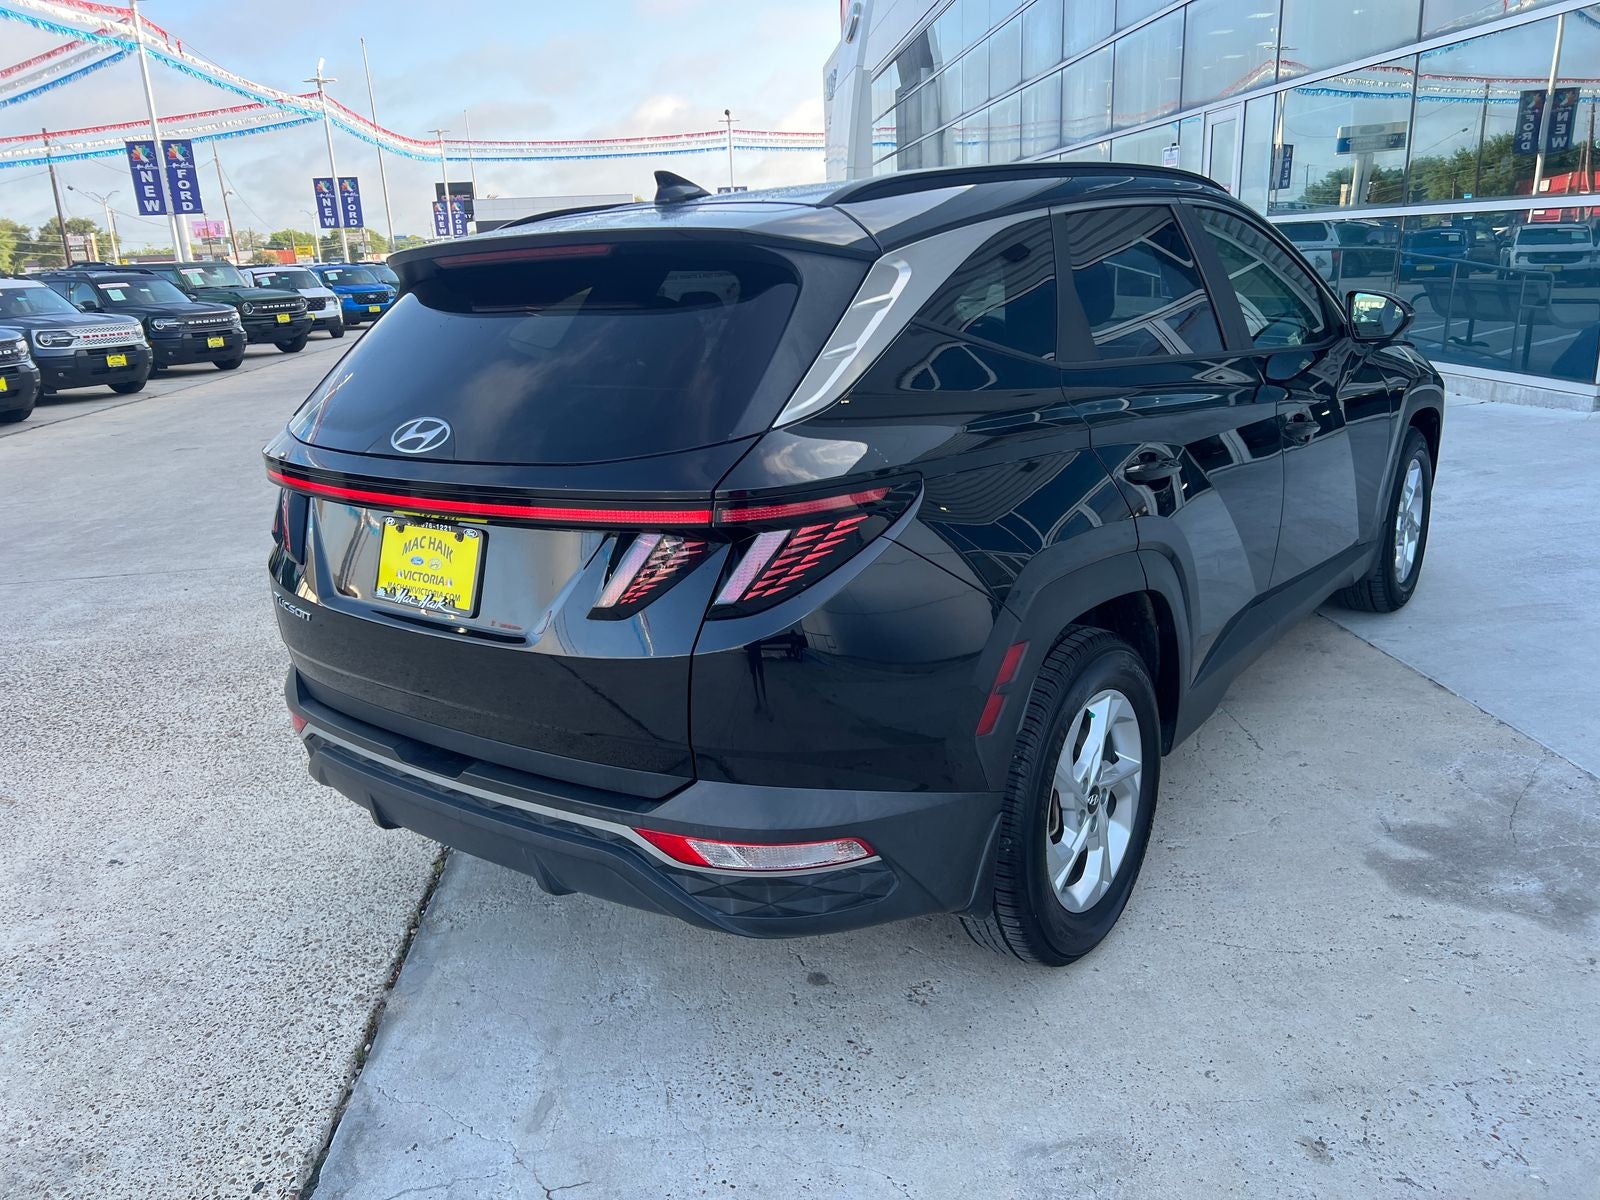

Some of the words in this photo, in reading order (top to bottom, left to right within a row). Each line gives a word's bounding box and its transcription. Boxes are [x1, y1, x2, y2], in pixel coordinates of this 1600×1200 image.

[140, 170, 160, 212] NEW
[176, 169, 194, 211] FORD
[322, 197, 335, 226] NEW
[347, 196, 358, 226] FORD
[437, 214, 447, 235] NEW
[455, 214, 463, 235] FORD
[82, 331, 130, 339] BRONCO
[402, 535, 426, 556] MAC
[428, 536, 453, 563] HAIK
[403, 569, 445, 587] VICTORIA
